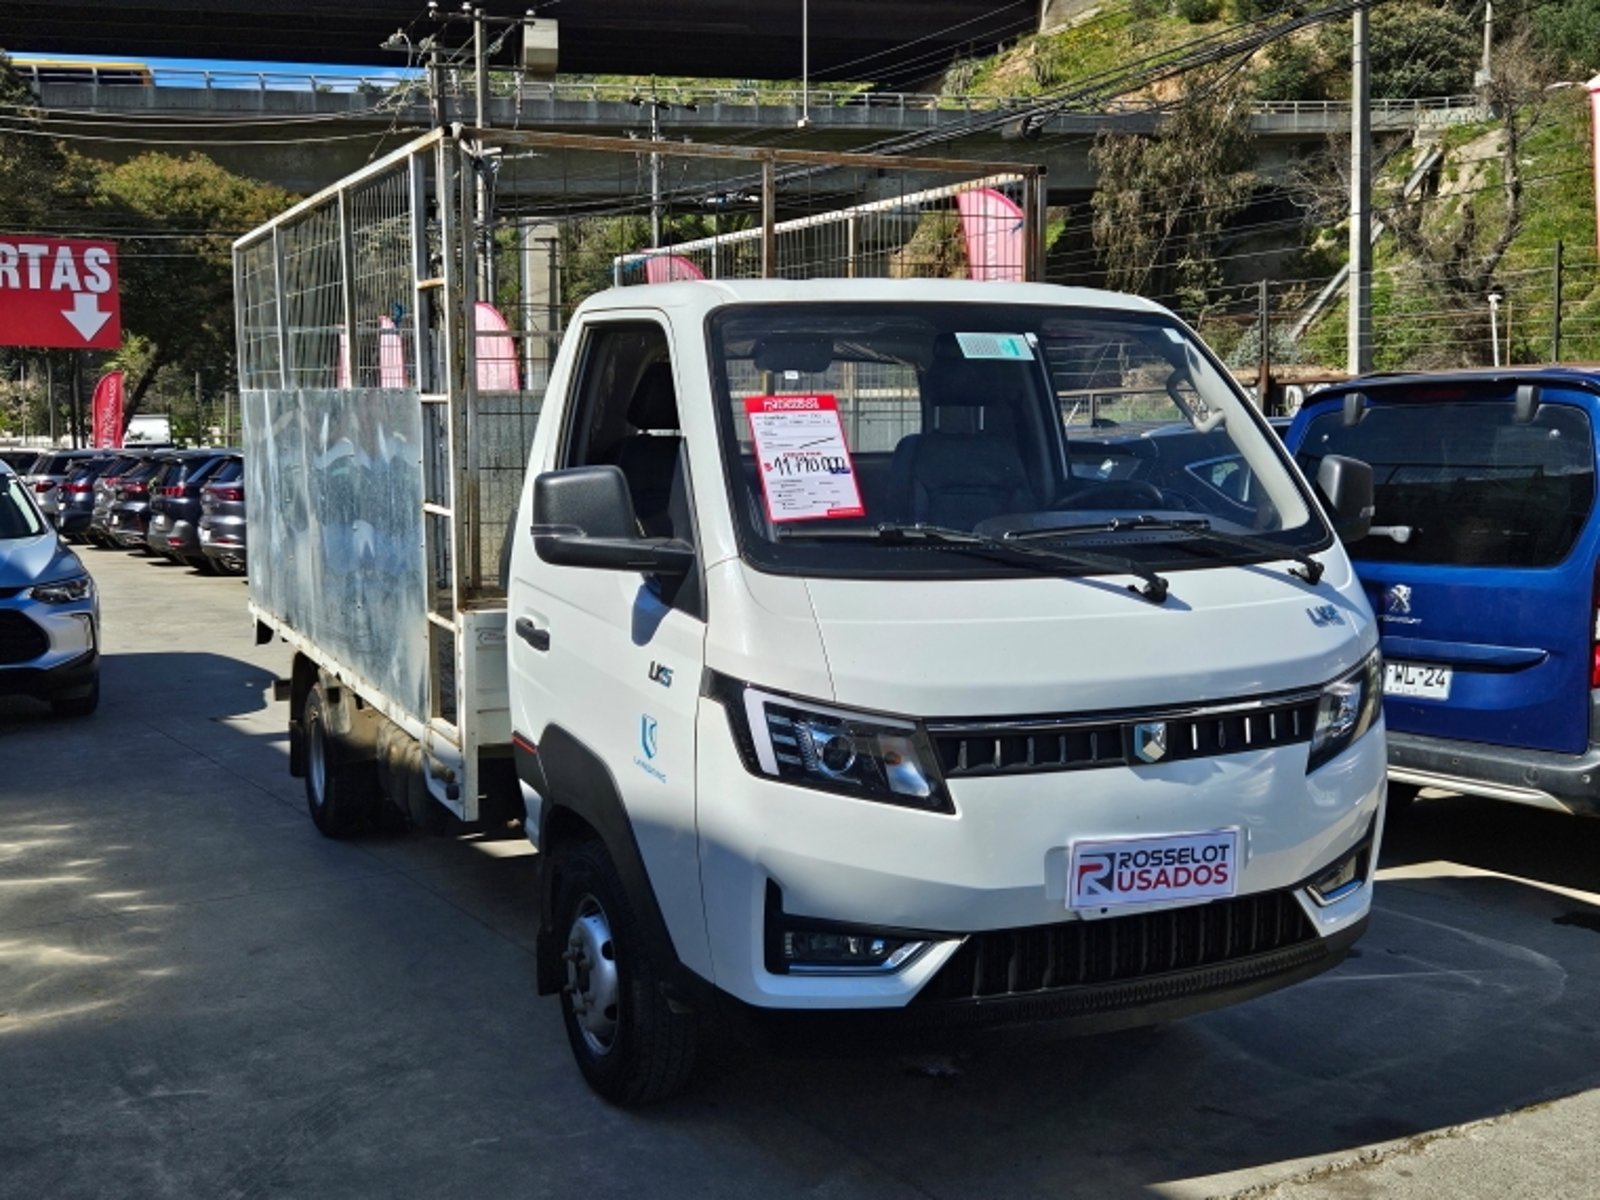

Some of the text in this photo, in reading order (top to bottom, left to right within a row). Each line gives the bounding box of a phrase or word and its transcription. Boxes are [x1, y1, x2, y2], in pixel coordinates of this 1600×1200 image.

[0, 243, 112, 293] RTAS
[1118, 844, 1230, 869] ROSSELOT
[1117, 863, 1228, 892] USADOS
